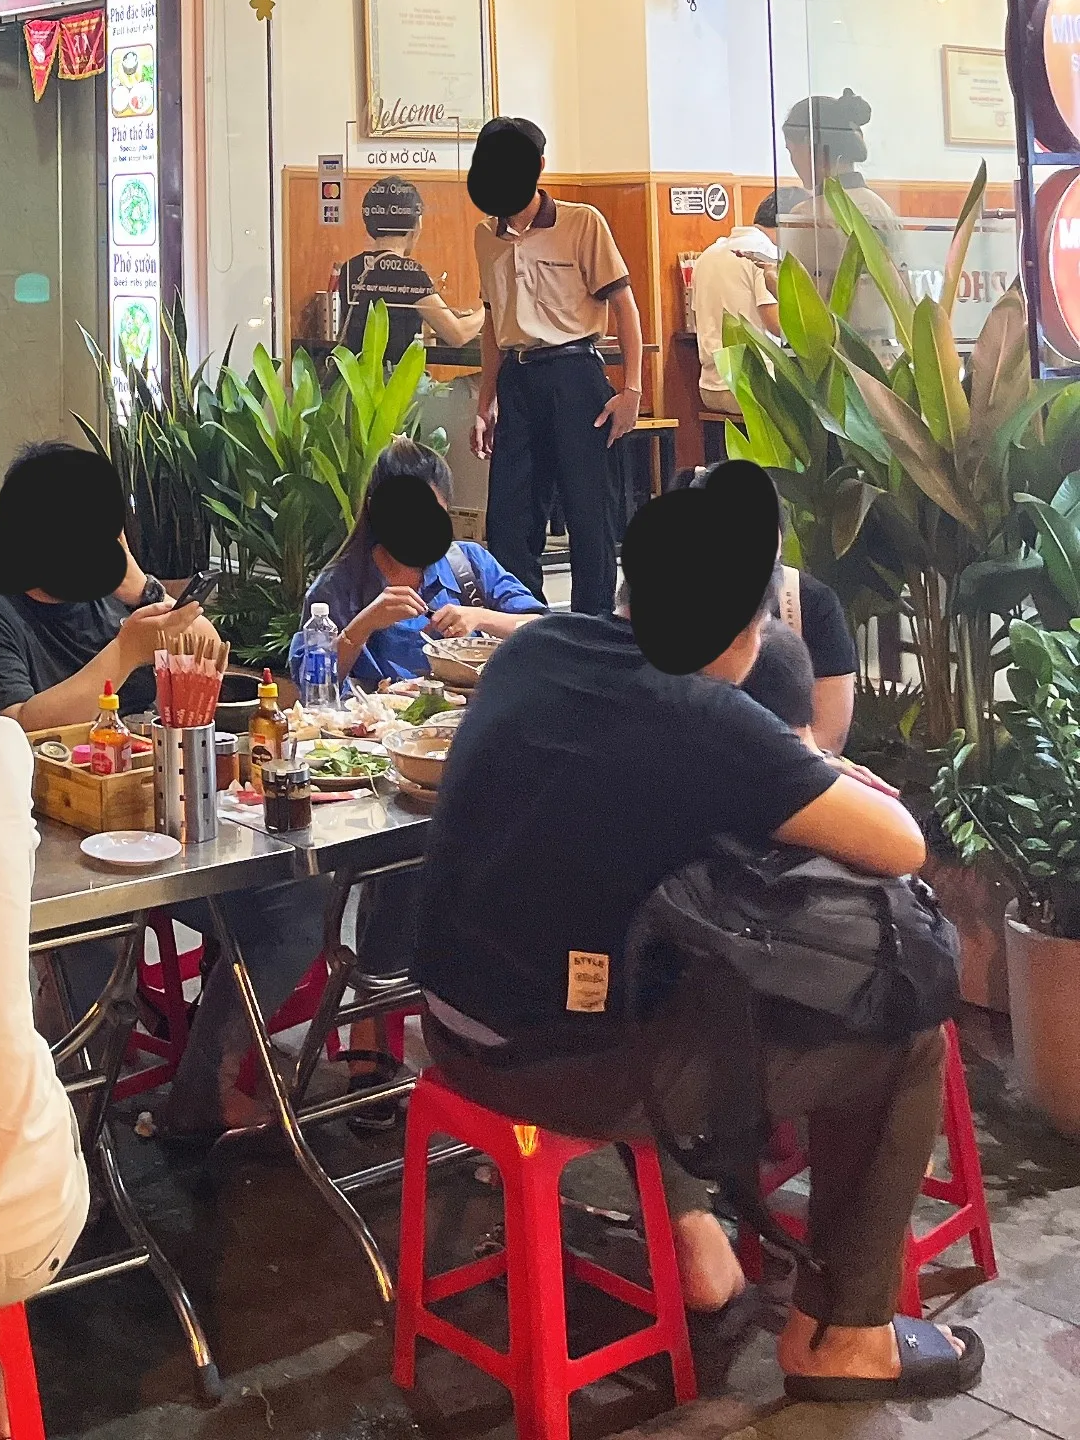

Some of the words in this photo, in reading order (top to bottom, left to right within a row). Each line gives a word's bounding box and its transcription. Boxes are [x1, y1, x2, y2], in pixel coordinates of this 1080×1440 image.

[367, 149, 388, 164] GIỜ
[390, 147, 409, 164] MỞ
[113, 252, 133, 274] Phở
